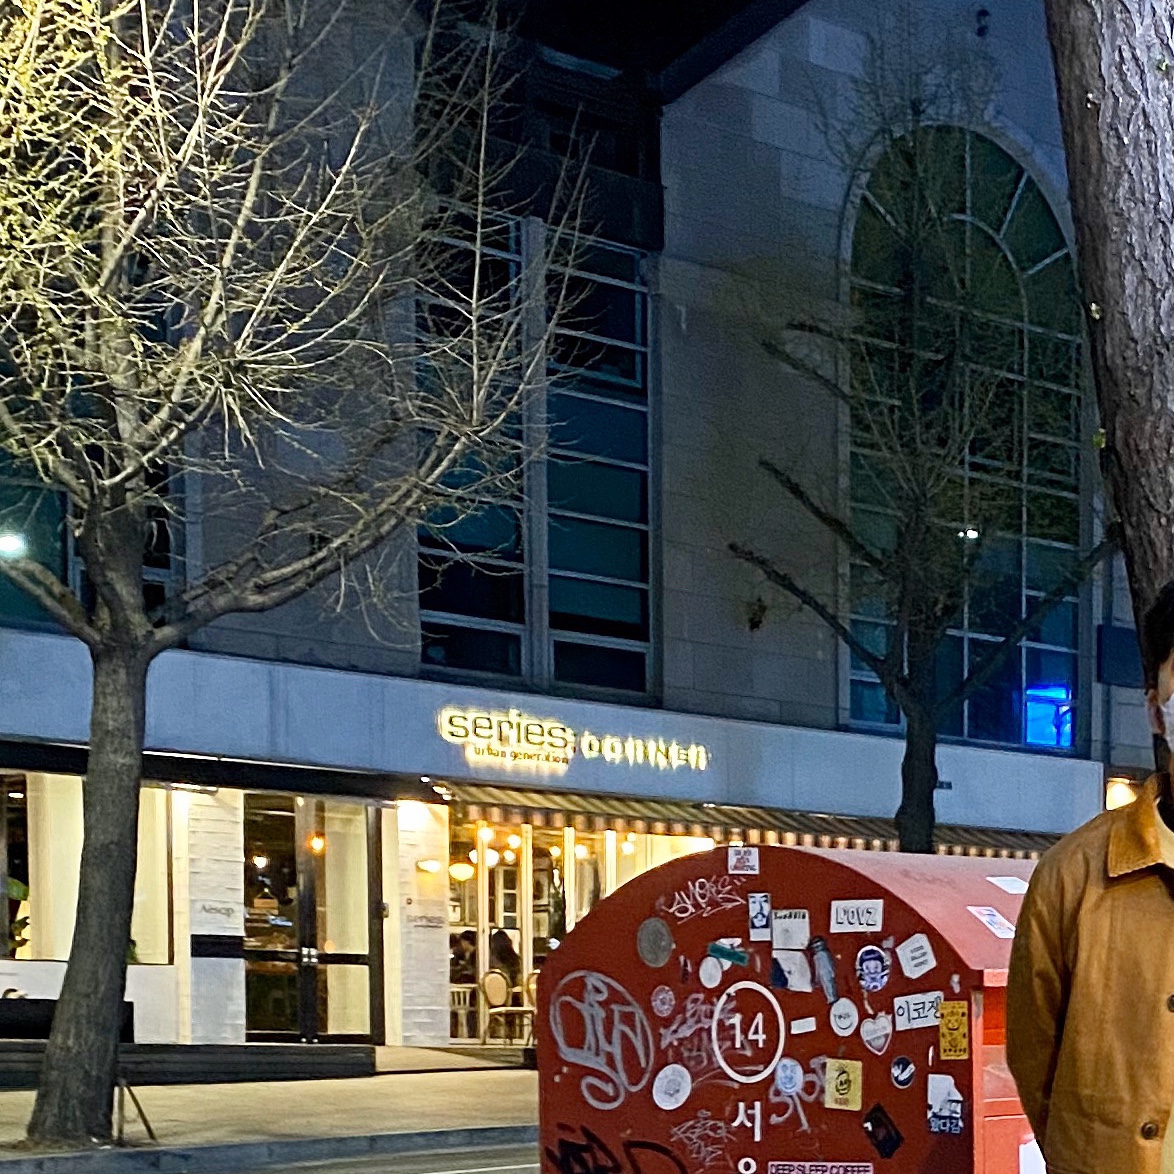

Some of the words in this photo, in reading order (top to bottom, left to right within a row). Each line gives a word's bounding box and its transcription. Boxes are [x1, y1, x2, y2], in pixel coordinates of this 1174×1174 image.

[447, 712, 568, 749] series
[475, 744, 507, 758] urban
[729, 1013, 766, 1049] 14
